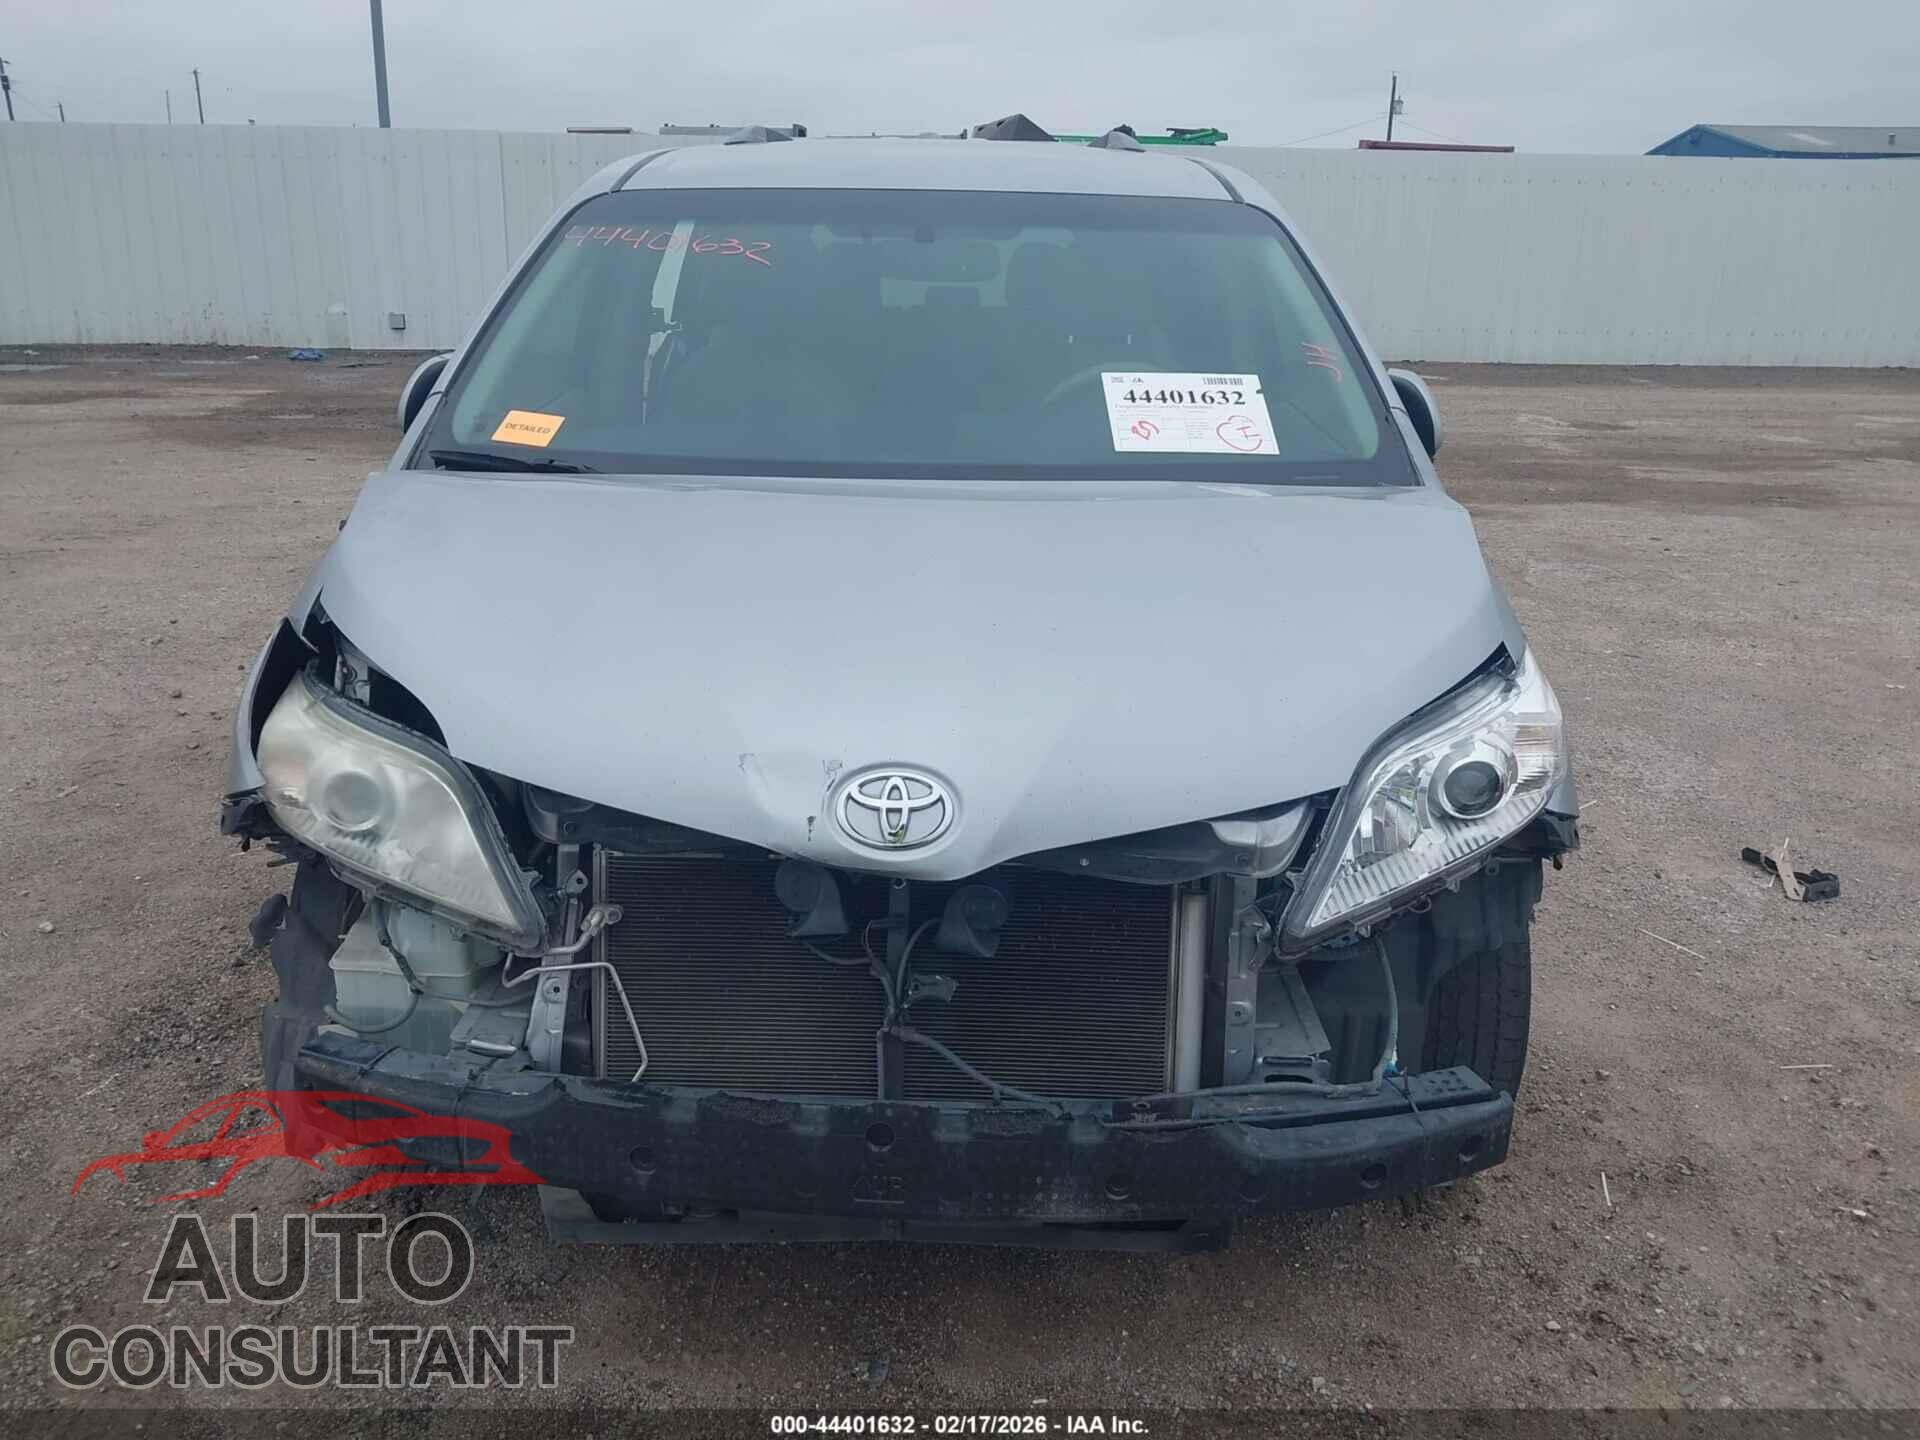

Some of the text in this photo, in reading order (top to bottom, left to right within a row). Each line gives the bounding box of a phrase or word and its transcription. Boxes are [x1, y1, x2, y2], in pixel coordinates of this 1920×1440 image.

[564, 225, 772, 266] 4440632
[1122, 388, 1247, 406] 44401632
[503, 421, 552, 435] DETAILED
